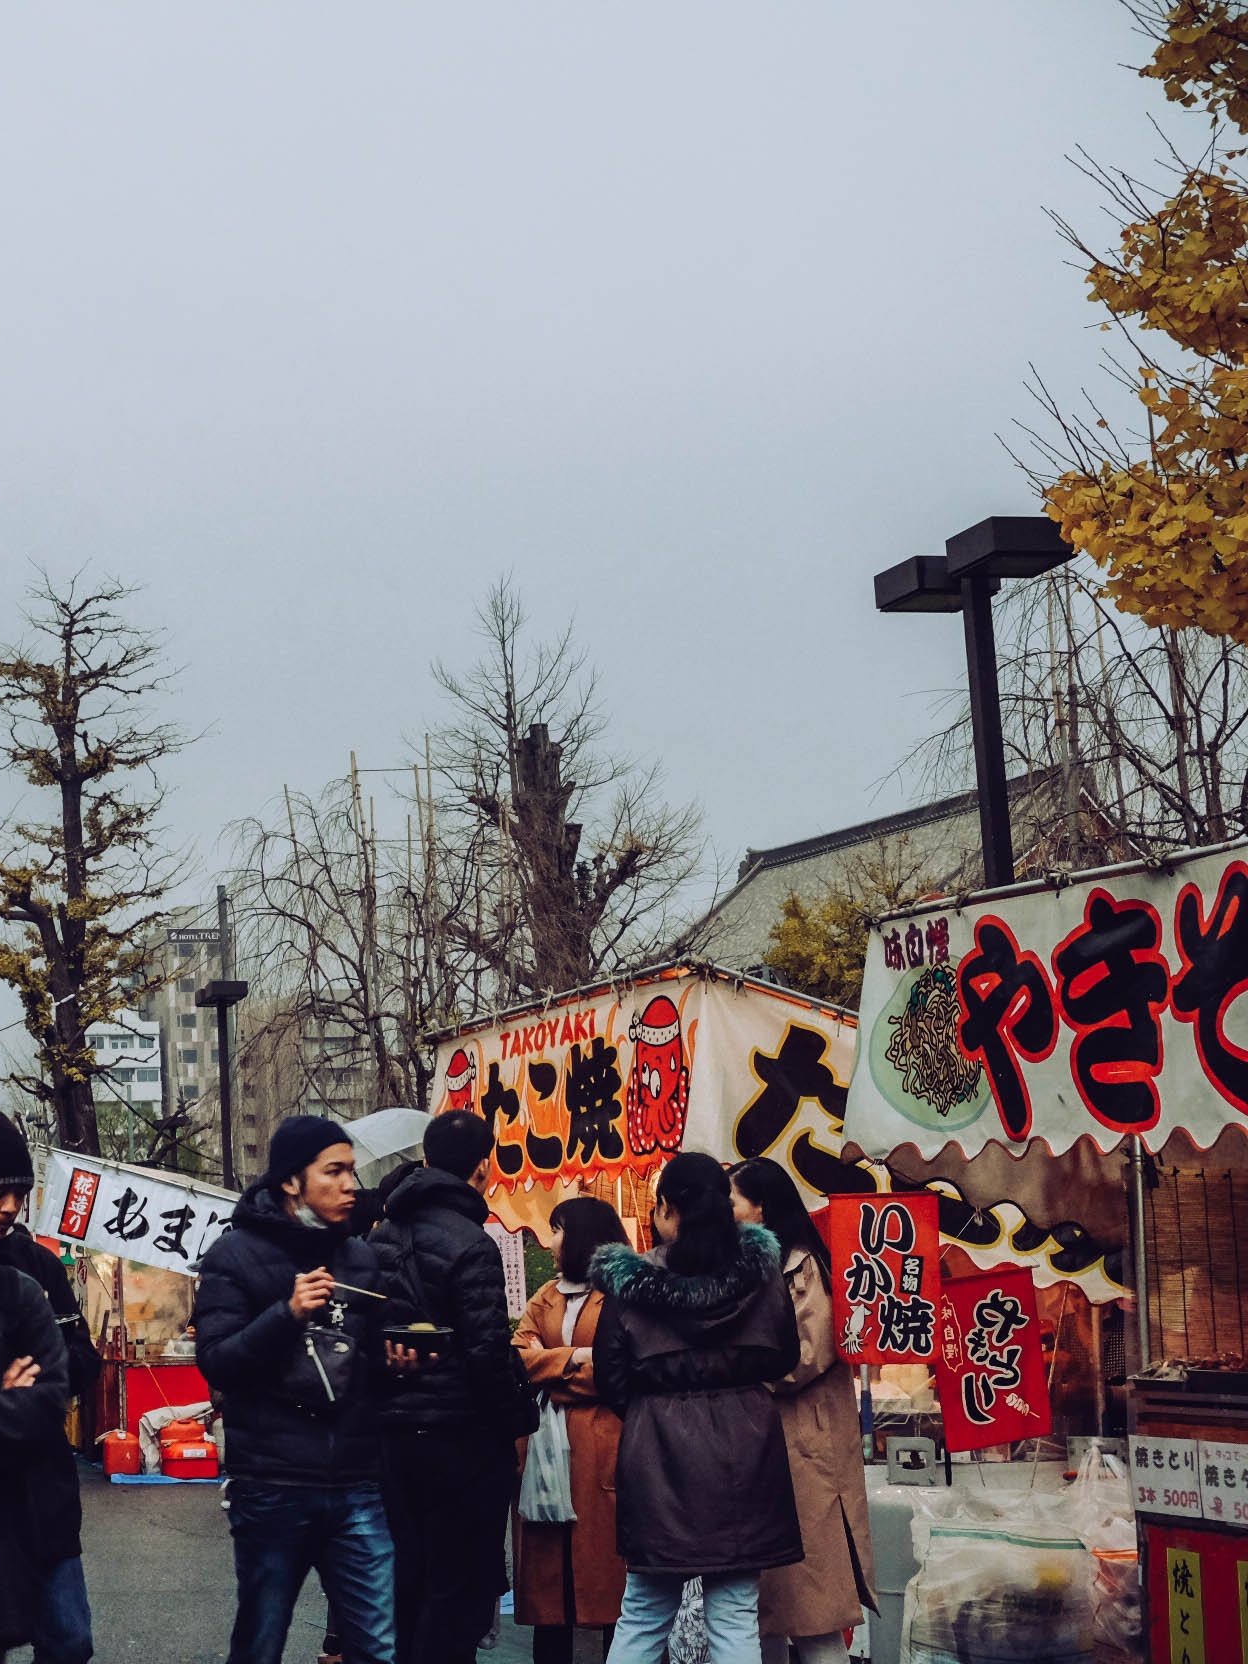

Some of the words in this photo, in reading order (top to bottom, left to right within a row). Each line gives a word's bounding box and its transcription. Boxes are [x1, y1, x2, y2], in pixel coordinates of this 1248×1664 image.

[882, 916, 950, 971] 味自慢
[499, 1008, 597, 1060] TAKOYAKI
[481, 1036, 624, 1176] たこ焼
[845, 1202, 936, 1356] いか焼
[901, 1257, 921, 1293] 名物
[1135, 1445, 1194, 1472] 焼きとり
[1138, 1486, 1157, 1505] 3本
[1164, 1488, 1199, 1510] 500円
